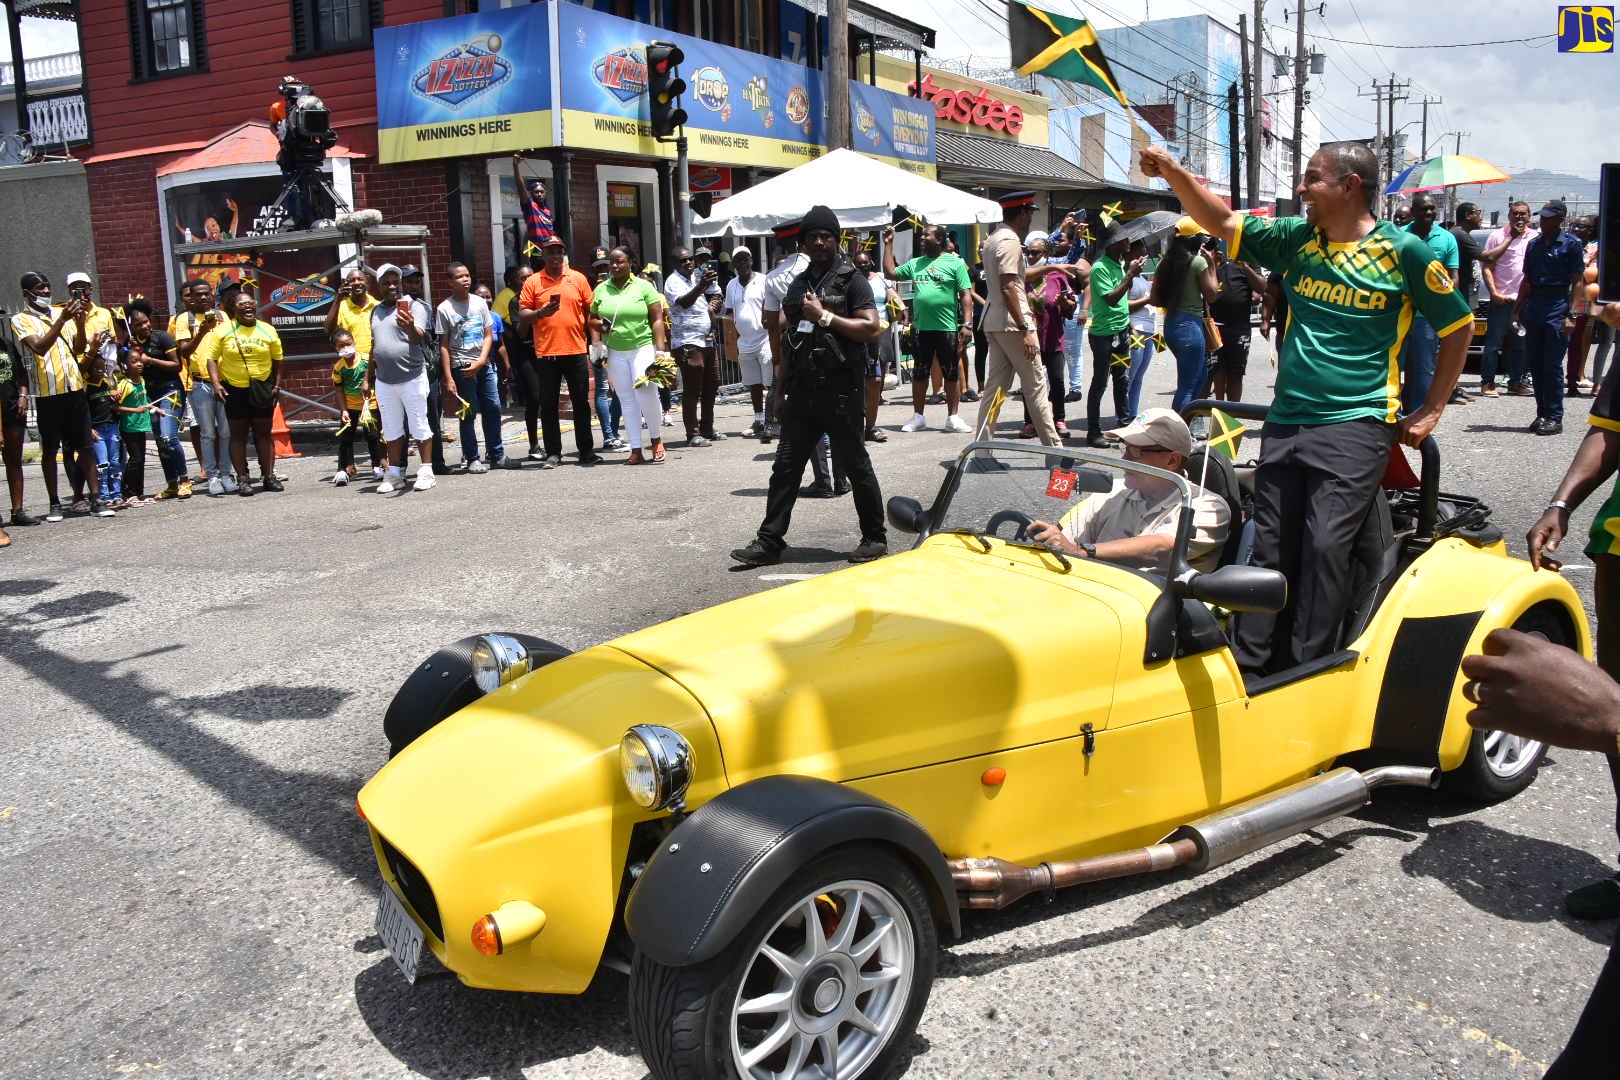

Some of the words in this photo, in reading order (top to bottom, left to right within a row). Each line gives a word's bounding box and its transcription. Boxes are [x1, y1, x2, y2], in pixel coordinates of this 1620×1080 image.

[907, 73, 1024, 136] tastee
[416, 122, 476, 141] WINNINGS
[479, 119, 512, 134] HERE
[594, 118, 637, 135] WINNINGS
[699, 133, 732, 148] WINNINGS
[732, 137, 750, 150] HERE
[781, 143, 808, 156] WINNINGS
[1293, 274, 1388, 310] JAMAICA
[271, 316, 297, 325] BELIEVE
[1052, 478, 1069, 492] 23
